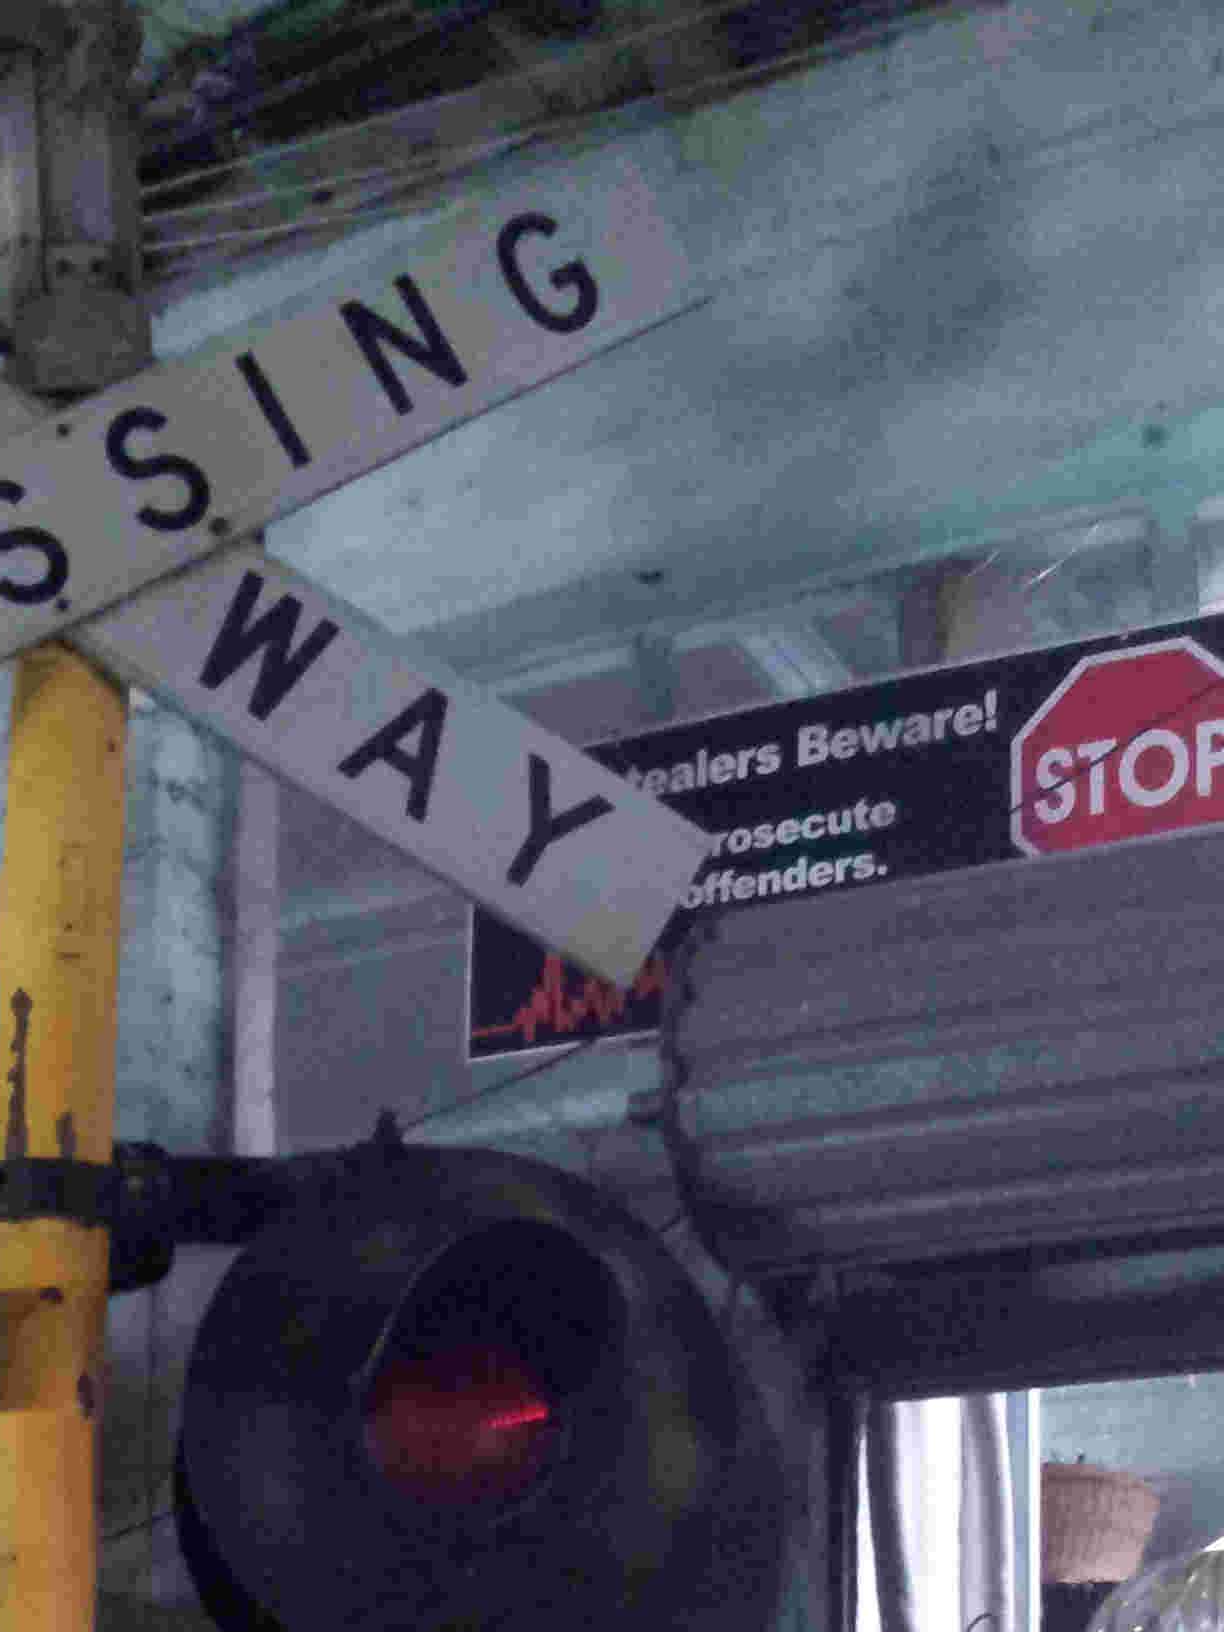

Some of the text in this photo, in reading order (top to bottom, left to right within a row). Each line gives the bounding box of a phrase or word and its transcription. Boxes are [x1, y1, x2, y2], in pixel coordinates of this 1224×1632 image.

[198, 571, 617, 885] WAY
[625, 689, 998, 795] tealers Beware!
[709, 797, 897, 857] rosecute
[680, 853, 888, 910] offenders.
